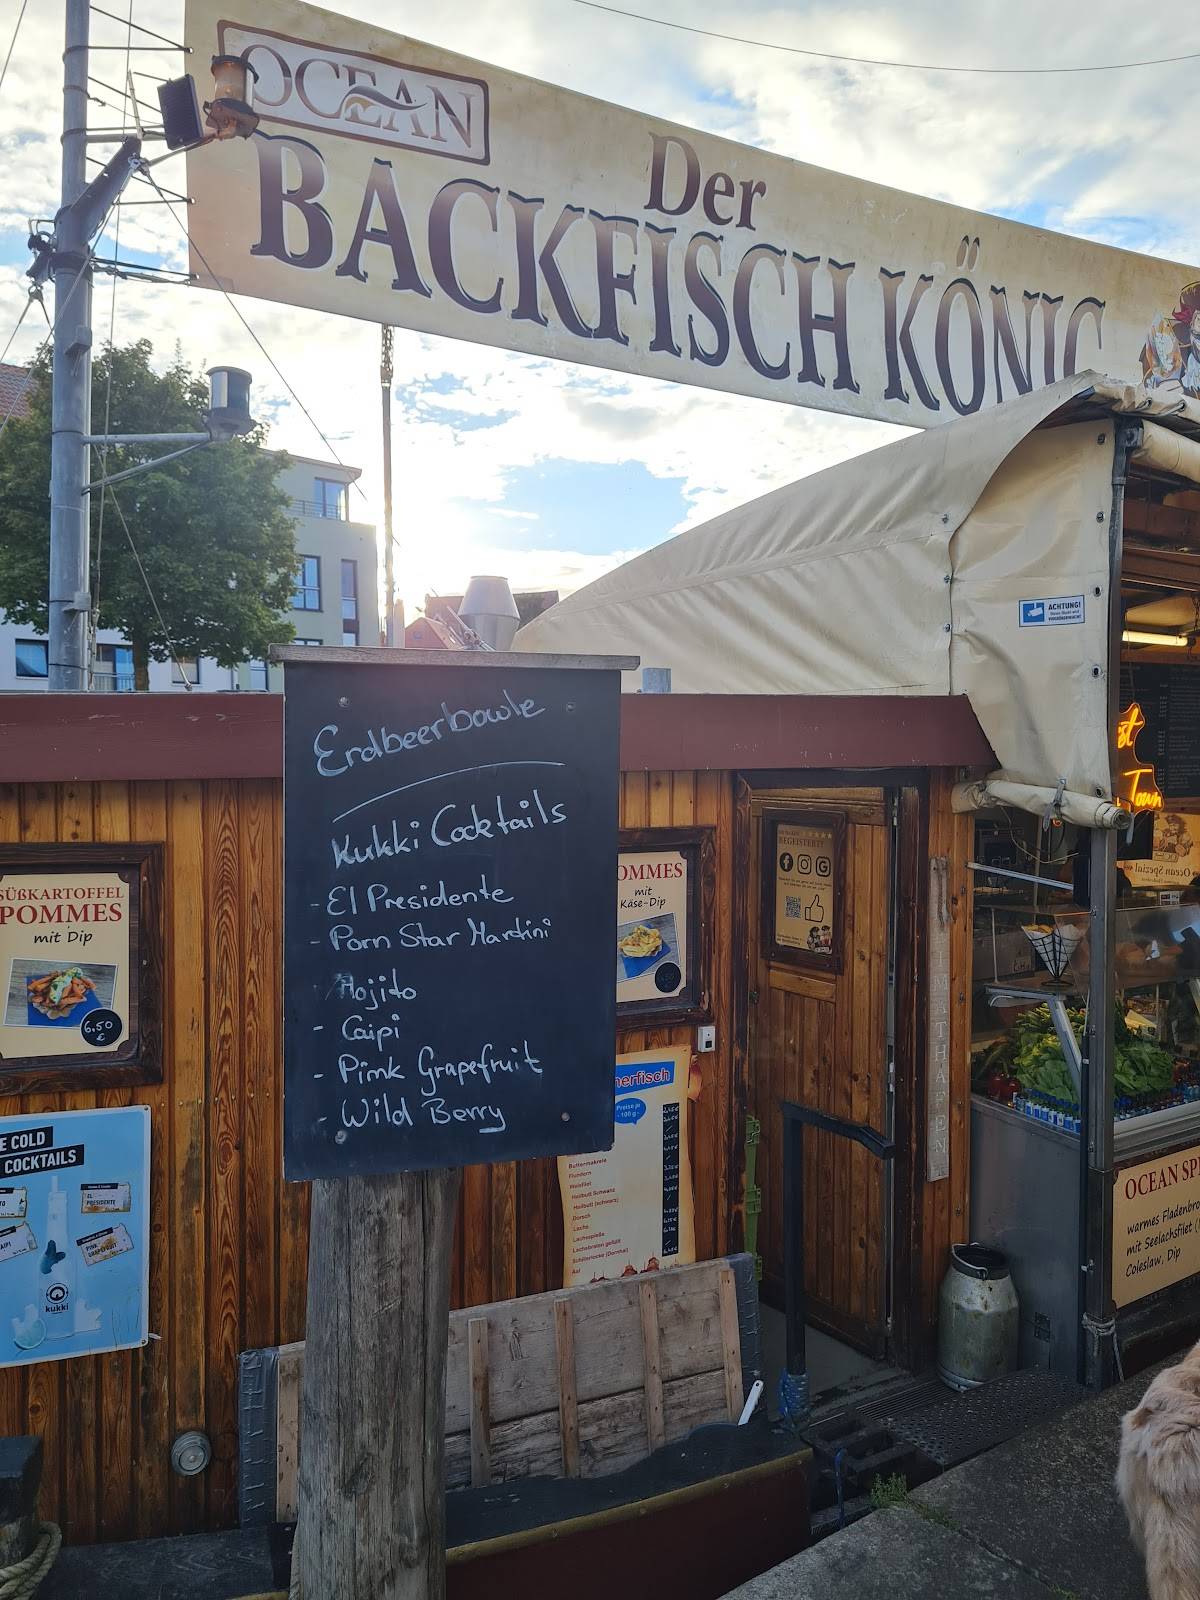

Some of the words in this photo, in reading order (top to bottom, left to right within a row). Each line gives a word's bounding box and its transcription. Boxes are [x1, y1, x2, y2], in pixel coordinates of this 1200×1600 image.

[241, 44, 474, 149] OCEAN
[645, 132, 767, 231] Der
[250, 131, 859, 393] BACKFISCH
[1048, 601, 1081, 610] ACHTUNG!
[313, 689, 546, 777] Erdbeerbowle
[1122, 767, 1163, 808] Town
[331, 819, 420, 869] Kukki
[431, 788, 567, 847] Cocktails
[326, 886, 357, 916] El
[367, 873, 515, 912] Presidente
[634, 885, 653, 897] mit
[0, 902, 123, 924] POMMES
[33, 930, 62, 944] mit
[66, 929, 94, 946] Dip
[398, 921, 461, 948] Star
[466, 917, 552, 947] Martini
[341, 1013, 401, 1052] Caipi
[338, 1053, 405, 1084] Pink
[417, 1039, 544, 1097] Grapefruit
[341, 1092, 414, 1128] Wild
[420, 1097, 507, 1134] Berry
[11, 1131, 46, 1150] COLD
[4, 1149, 77, 1174] COCKTAILS
[1125, 1163, 1179, 1200] OCEAN
[1126, 1240, 1142, 1257] mit
[1144, 1217, 1193, 1251] Seelachsfilet
[1127, 1216, 1160, 1235] warmes
[1167, 1246, 1181, 1264] Dip
[45, 1303, 69, 1313] kukki
